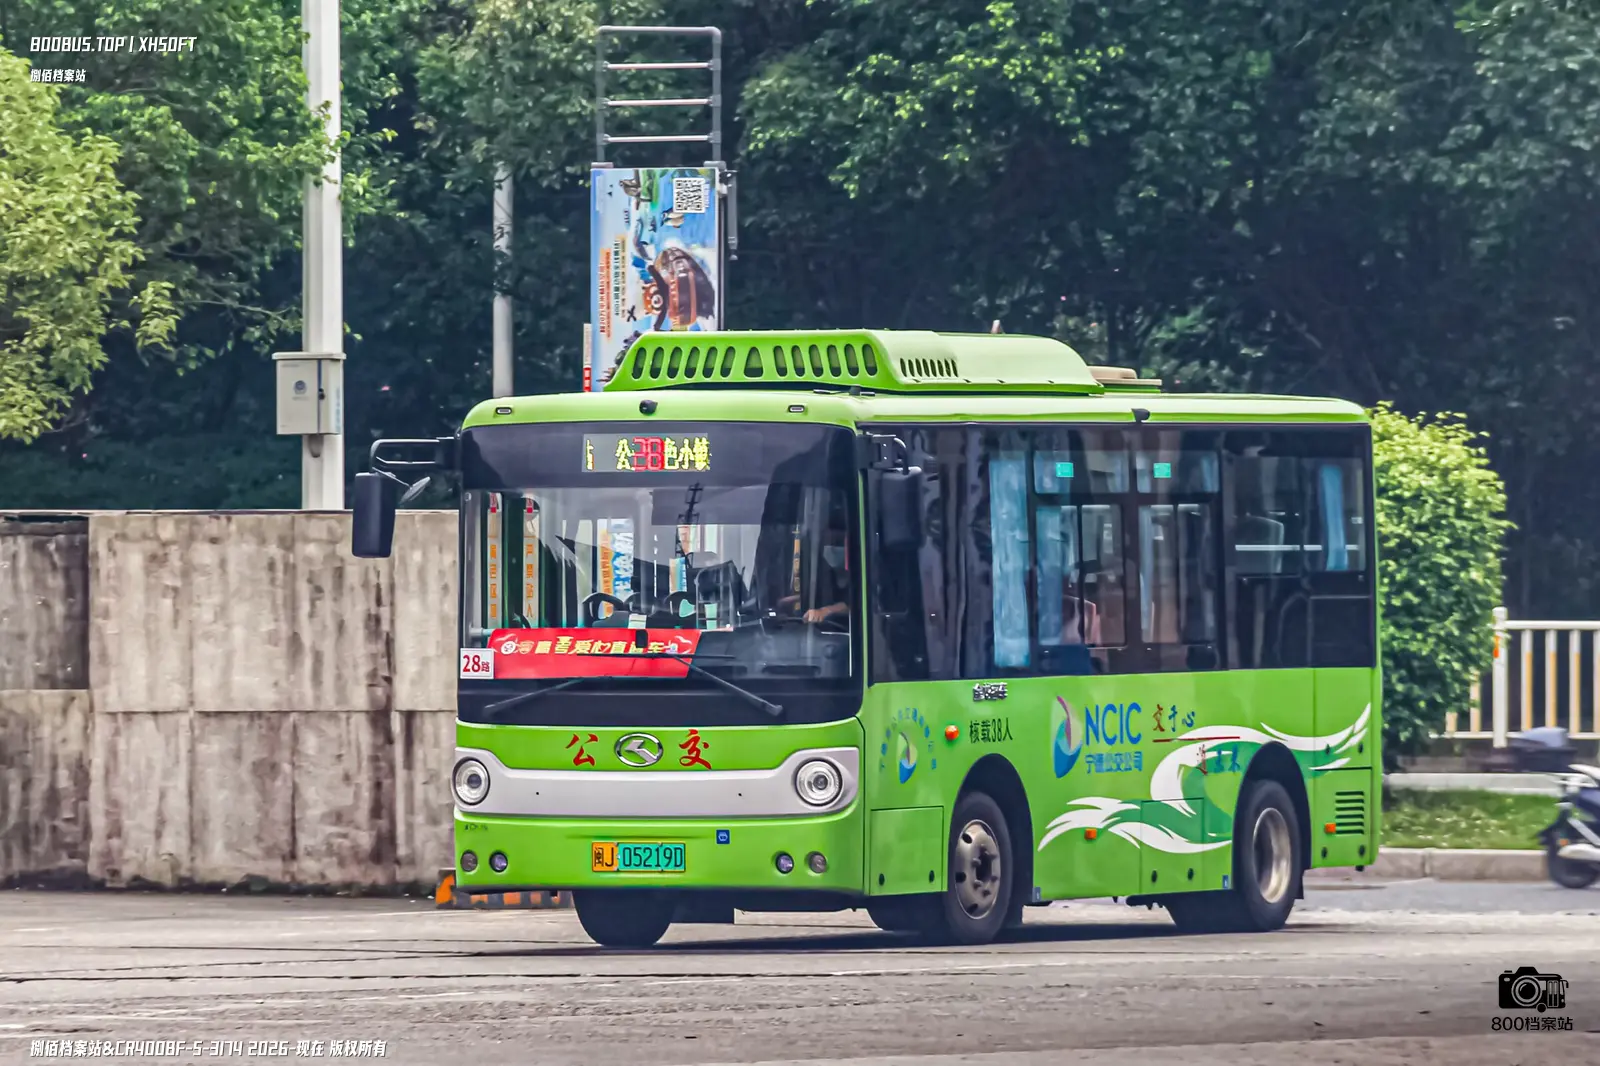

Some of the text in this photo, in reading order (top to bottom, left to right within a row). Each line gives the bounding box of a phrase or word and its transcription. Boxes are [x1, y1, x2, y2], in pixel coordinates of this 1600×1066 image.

[462, 654, 490, 673] 28路
[969, 717, 1013, 743] 核载38人
[1085, 702, 1142, 746] NCIC
[565, 728, 712, 770] 公 交
